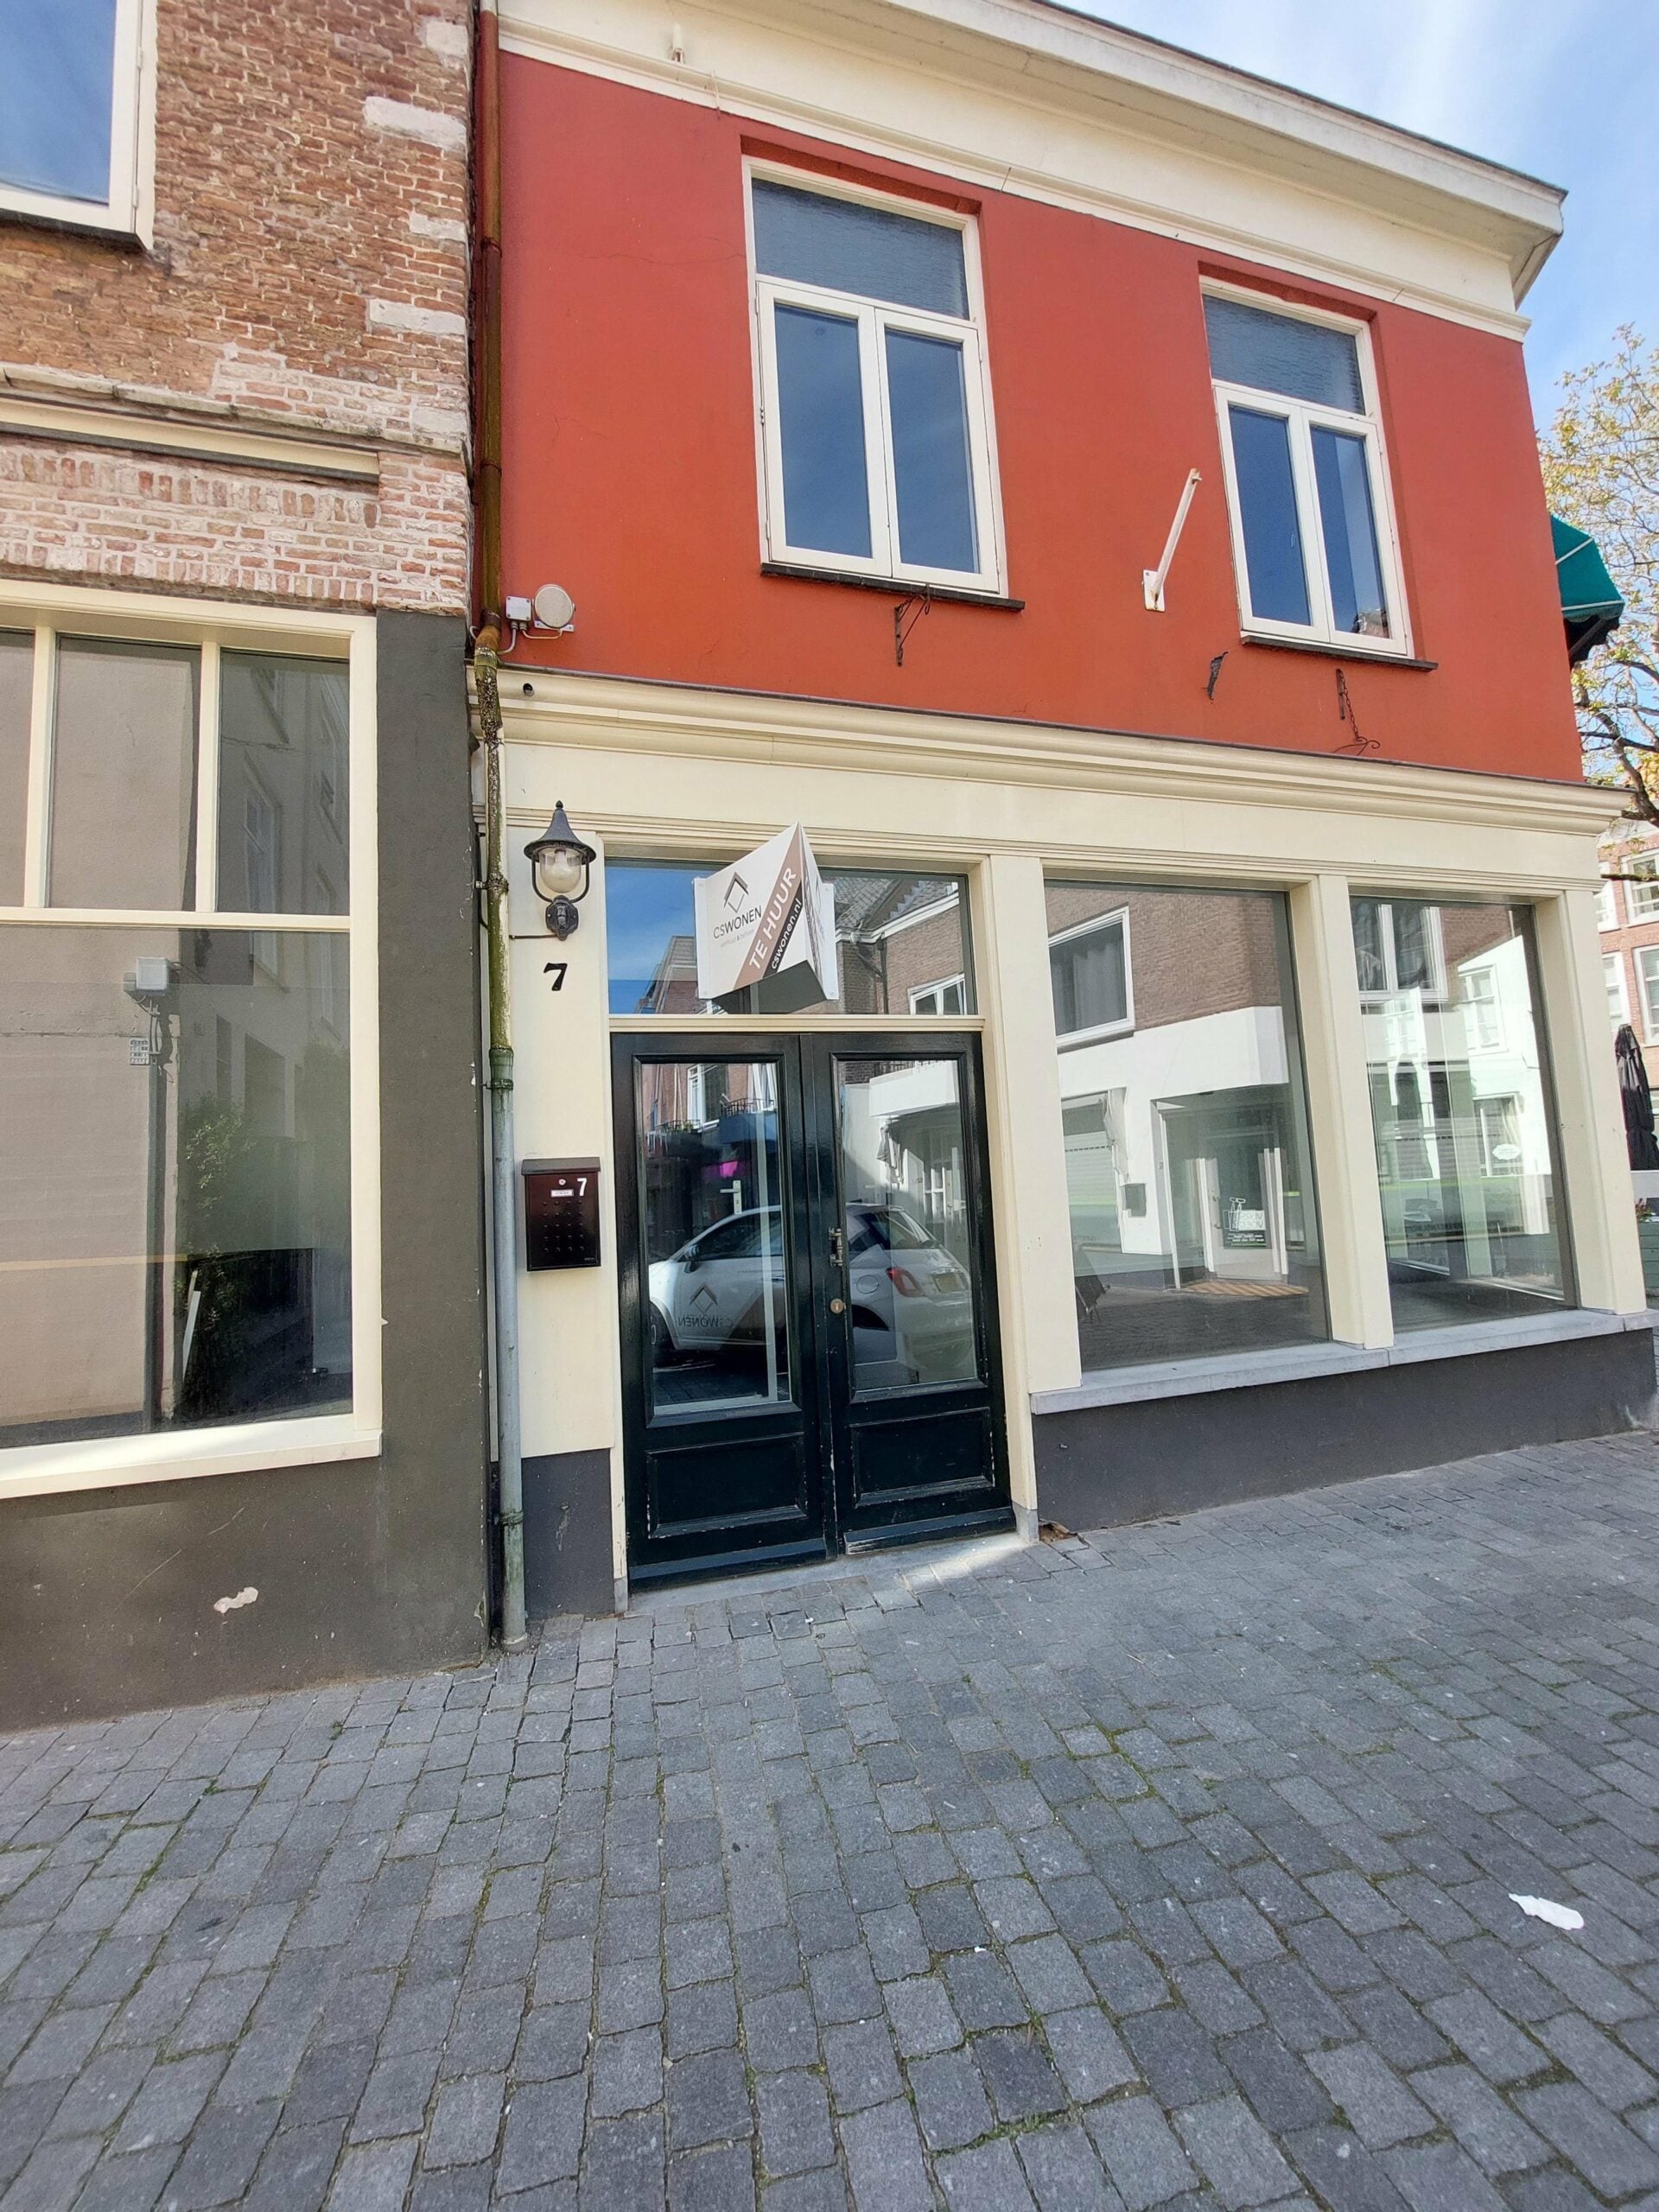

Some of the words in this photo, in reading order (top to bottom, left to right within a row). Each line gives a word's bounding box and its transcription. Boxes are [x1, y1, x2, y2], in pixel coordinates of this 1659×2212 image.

[713, 906, 762, 939] CSWONEN
[749, 939, 768, 969] TE
[763, 867, 797, 940] HUUR
[771, 898, 801, 969] cswonen.nl
[543, 962, 569, 992] 7
[576, 1177, 588, 1197] 7
